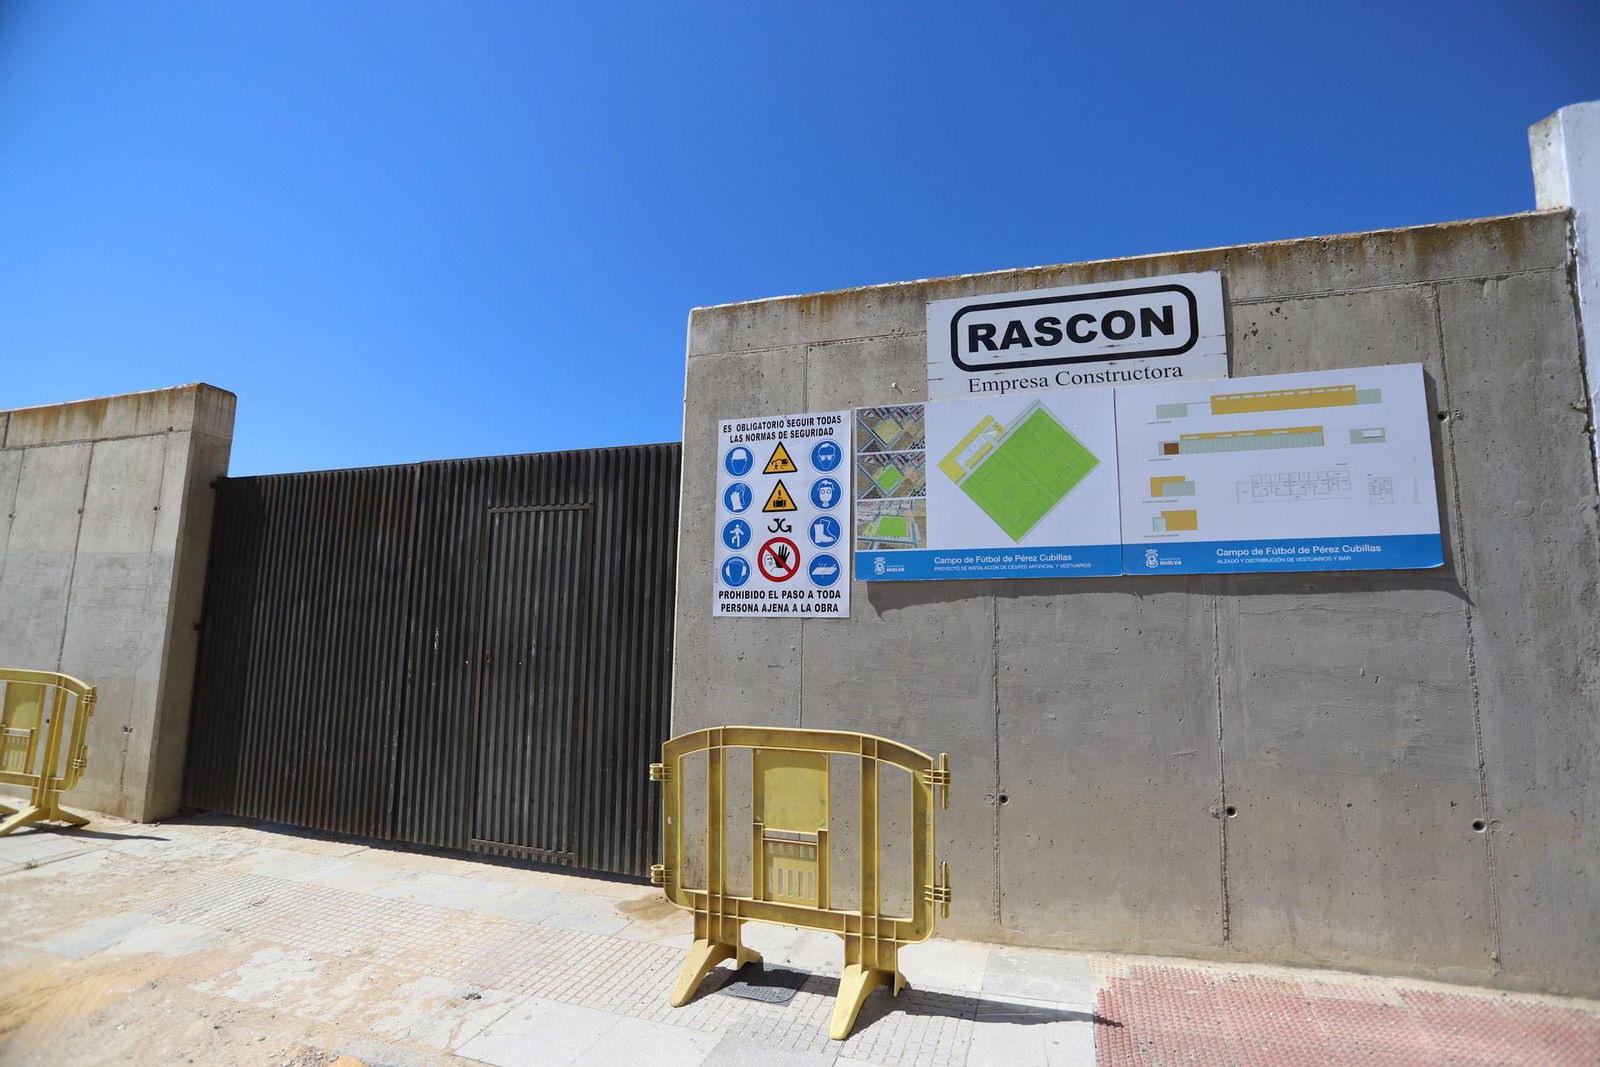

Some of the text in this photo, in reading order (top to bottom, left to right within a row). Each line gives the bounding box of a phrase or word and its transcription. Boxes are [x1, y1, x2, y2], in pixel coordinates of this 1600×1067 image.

[968, 305, 1175, 353] RASCON
[968, 366, 1183, 395] Empresa Constructora
[723, 415, 842, 434] ES OBLIGATORIO SEGUIR TODAS
[729, 427, 834, 443] LAS NORMAS DE SEGURIDAD
[1216, 548, 1249, 557] Campo
[1252, 548, 1264, 556] de
[1266, 546, 1295, 555] Fútbol
[1312, 545, 1340, 554] Pérez
[1342, 544, 1382, 552] Cubillas
[934, 554, 1072, 566] Campo de Fútbol de Pérez Cubillas
[718, 590, 842, 600] PROHIBIDO EL PASO A TODA
[720, 603, 839, 613] PERSONA AJENA A LA OBRA
